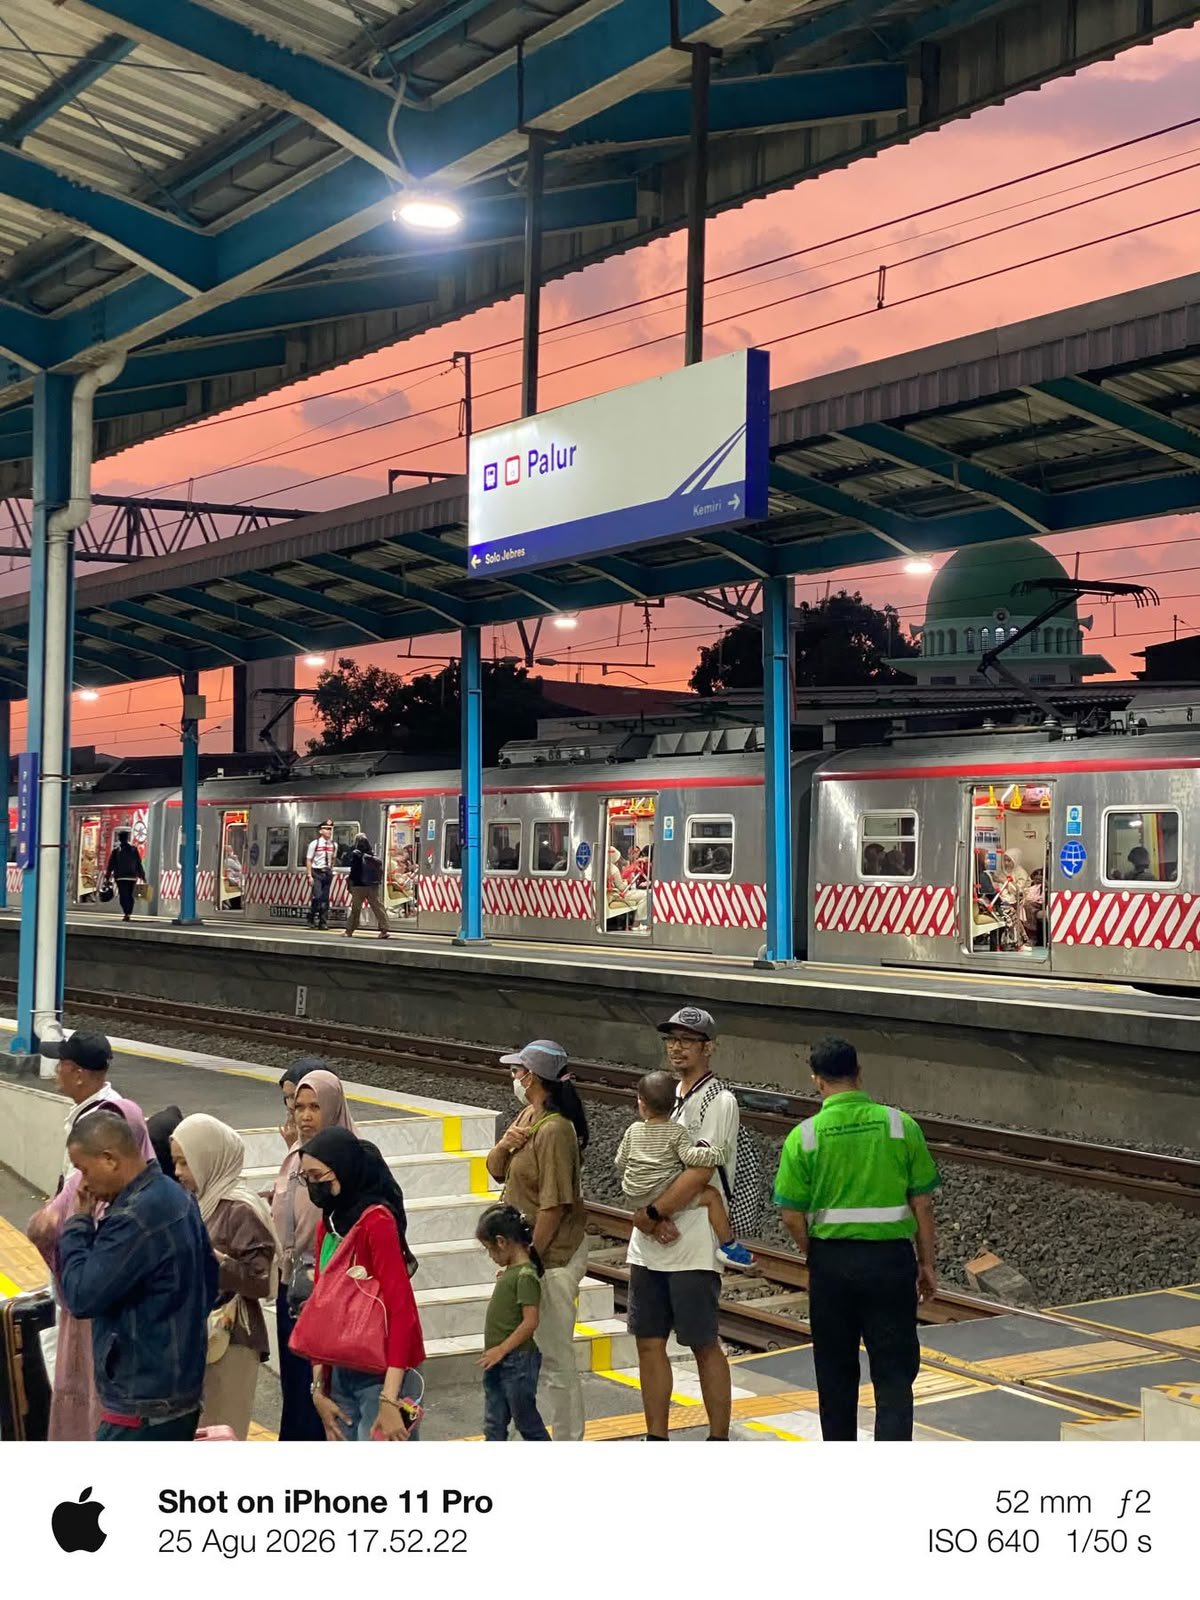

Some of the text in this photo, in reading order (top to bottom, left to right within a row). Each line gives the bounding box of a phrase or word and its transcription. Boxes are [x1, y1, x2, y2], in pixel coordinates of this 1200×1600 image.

[527, 443, 577, 478] Palur
[693, 499, 722, 516] Kemiri
[485, 548, 526, 565] Solo Jebres
